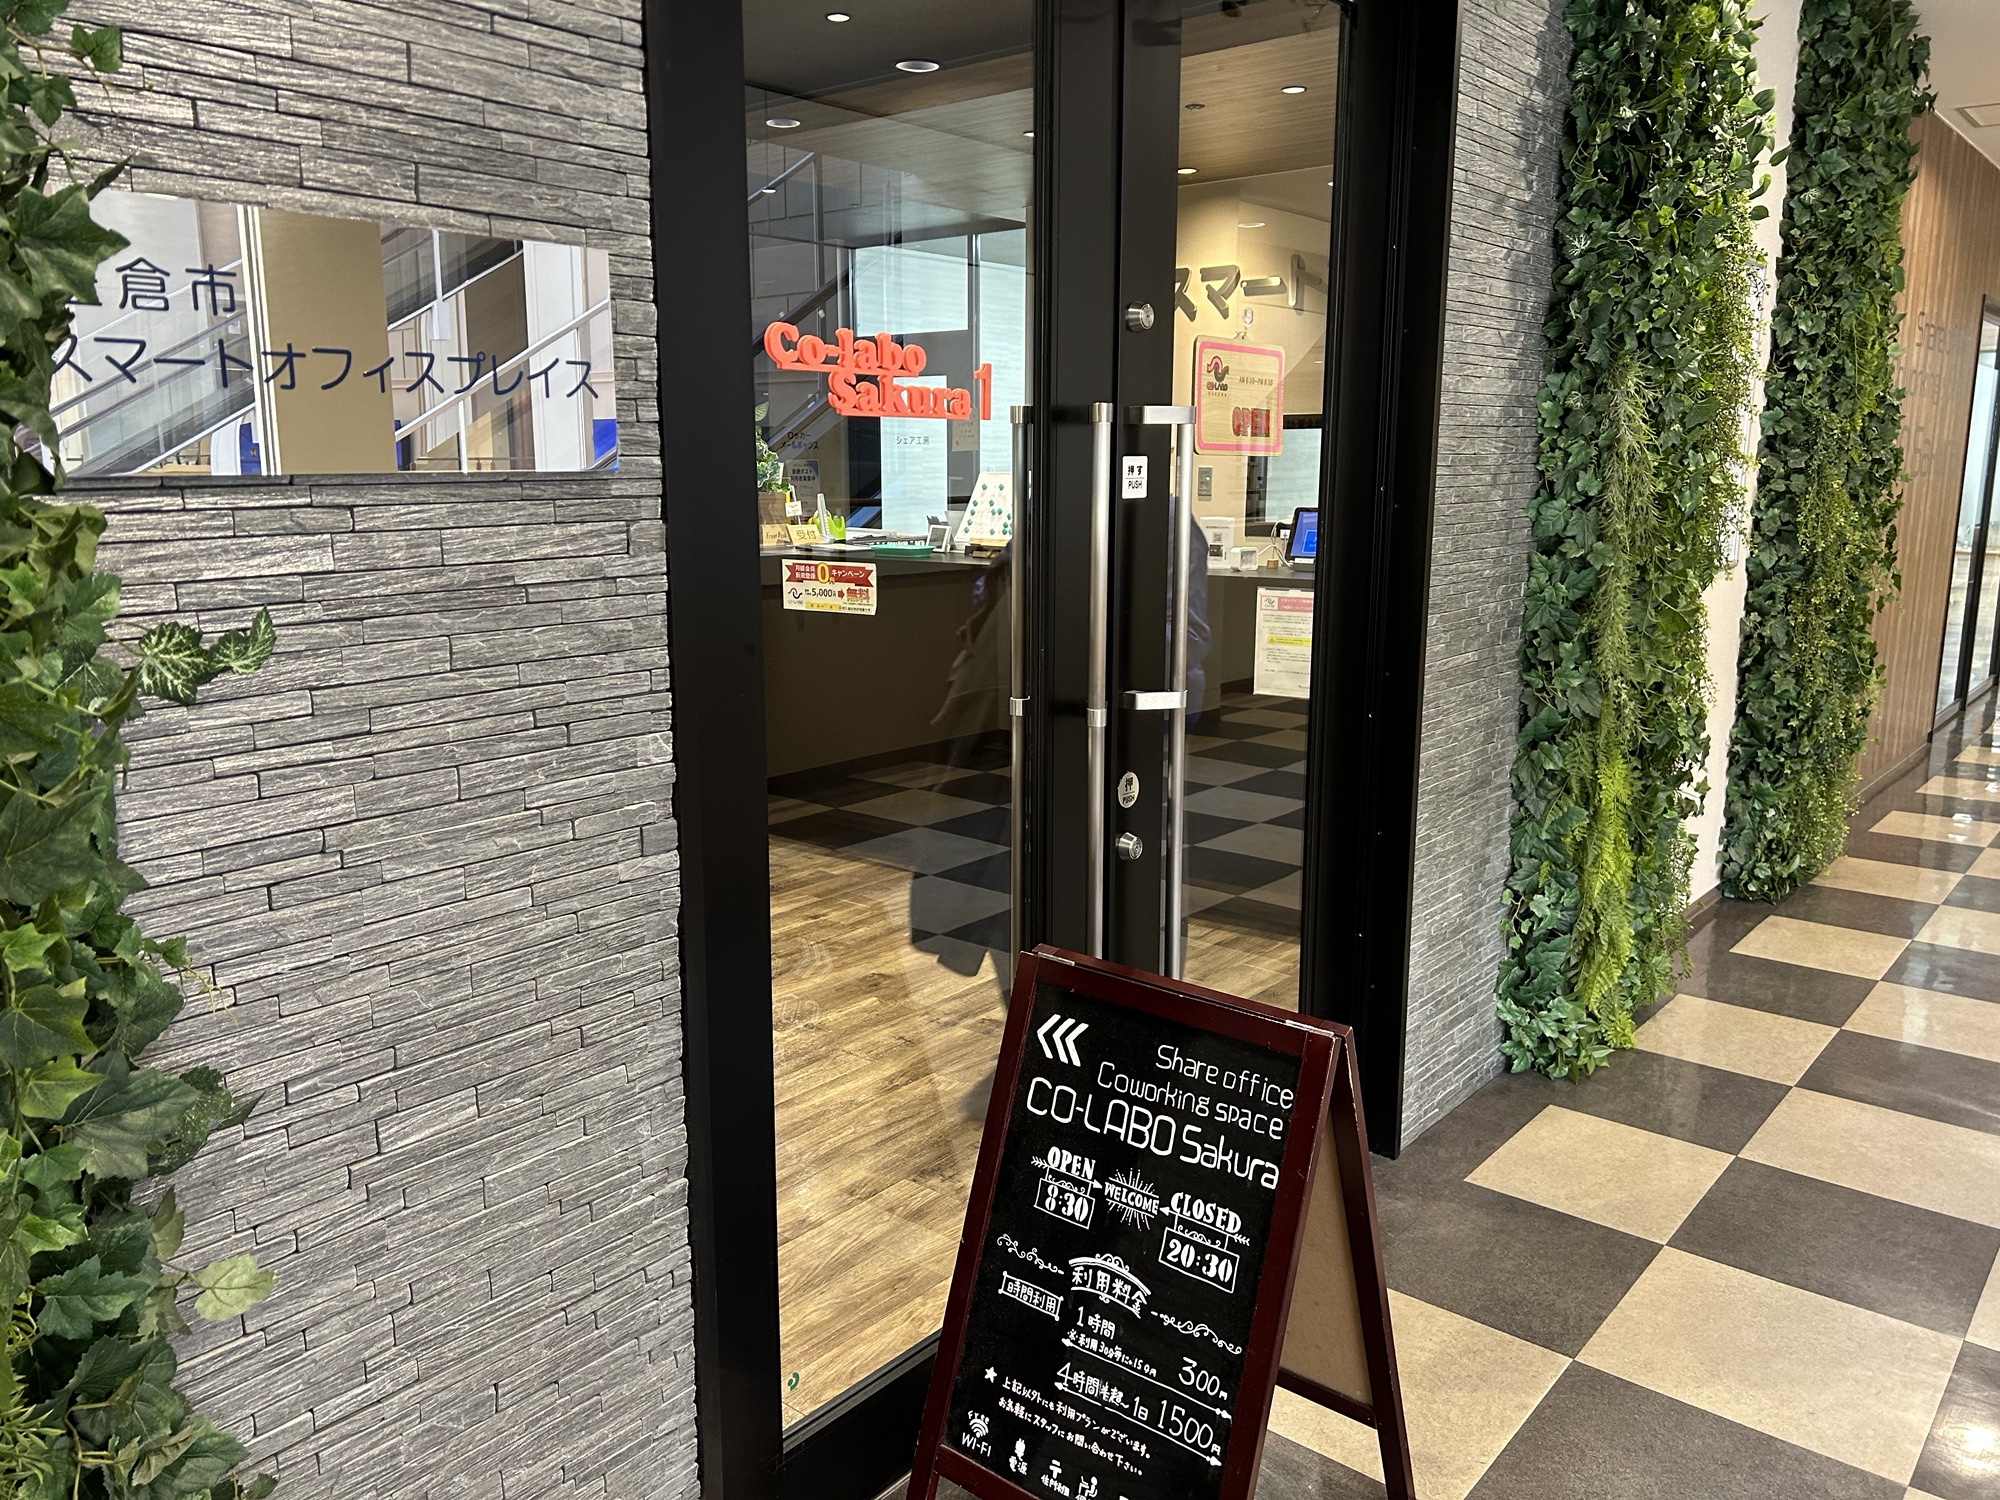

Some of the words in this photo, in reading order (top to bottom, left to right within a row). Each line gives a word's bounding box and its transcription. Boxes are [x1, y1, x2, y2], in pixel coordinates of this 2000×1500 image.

[66, 257, 237, 316] 倉市
[764, 322, 927, 376] Co-labo
[52, 334, 600, 400] スマートオフィスプレイス
[828, 371, 972, 420] Sakura
[1232, 406, 1270, 437] OPEN
[896, 436, 930, 445] シェア工房
[1128, 465, 1143, 476] 押す
[1128, 480, 1142, 489] PUSH
[797, 529, 816, 540] 受付
[831, 569, 865, 578] キャンペーン
[846, 587, 870, 603] 無料
[1123, 794, 1135, 804] PUSH
[1156, 1044, 1219, 1085] Share
[1222, 1070, 1294, 1110] office
[1097, 1061, 1210, 1117] Coworking
[1214, 1102, 1284, 1140] space
[1027, 1076, 1177, 1156] CO-LABO
[1179, 1125, 1280, 1190] Sakura
[1047, 1146, 1096, 1180] OPEN
[1045, 1184, 1089, 1222] 8:30
[1104, 1182, 1160, 1215] WELCOME
[1170, 1192, 1241, 1233] CLOSED
[1166, 1239, 1233, 1282] 20:30
[1007, 1281, 1057, 1313] 時間利用
[1072, 1266, 1147, 1315] 利用料金
[1077, 1306, 1115, 1339] 1時間
[1178, 1356, 1228, 1400] 300円
[968, 1410, 990, 1424] Free
[1158, 1400, 1221, 1456] 1500円
[1009, 1456, 1027, 1475] 電源
